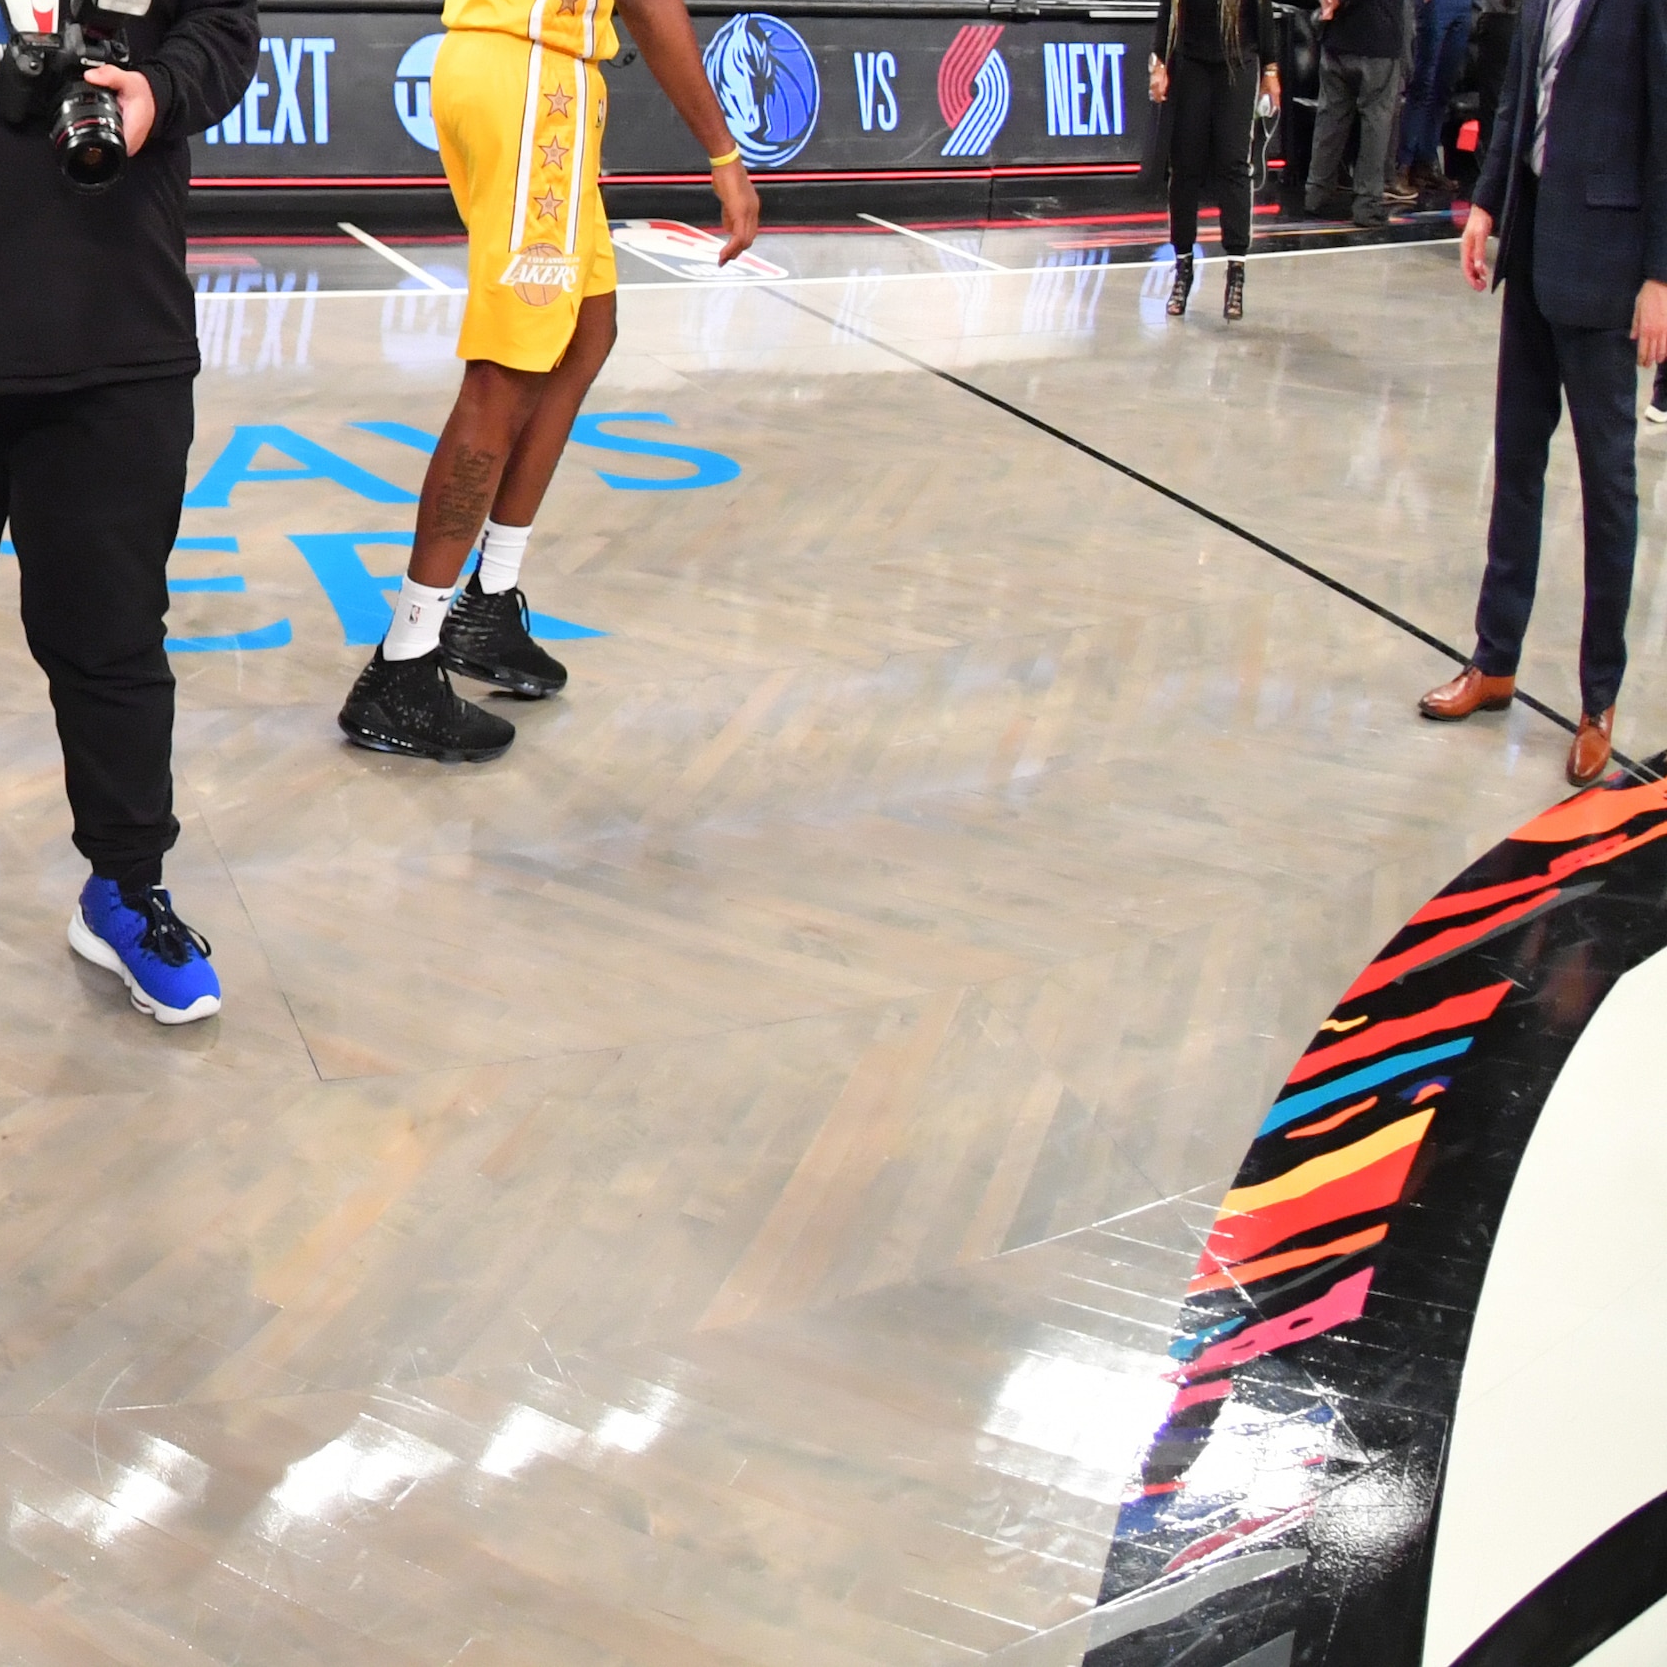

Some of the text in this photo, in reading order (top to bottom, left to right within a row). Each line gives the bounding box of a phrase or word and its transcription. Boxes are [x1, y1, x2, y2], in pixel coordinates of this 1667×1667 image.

[853, 51, 898, 131] VS
[1043, 42, 1126, 136] NEXT
[498, 254, 580, 293] LAKERS
